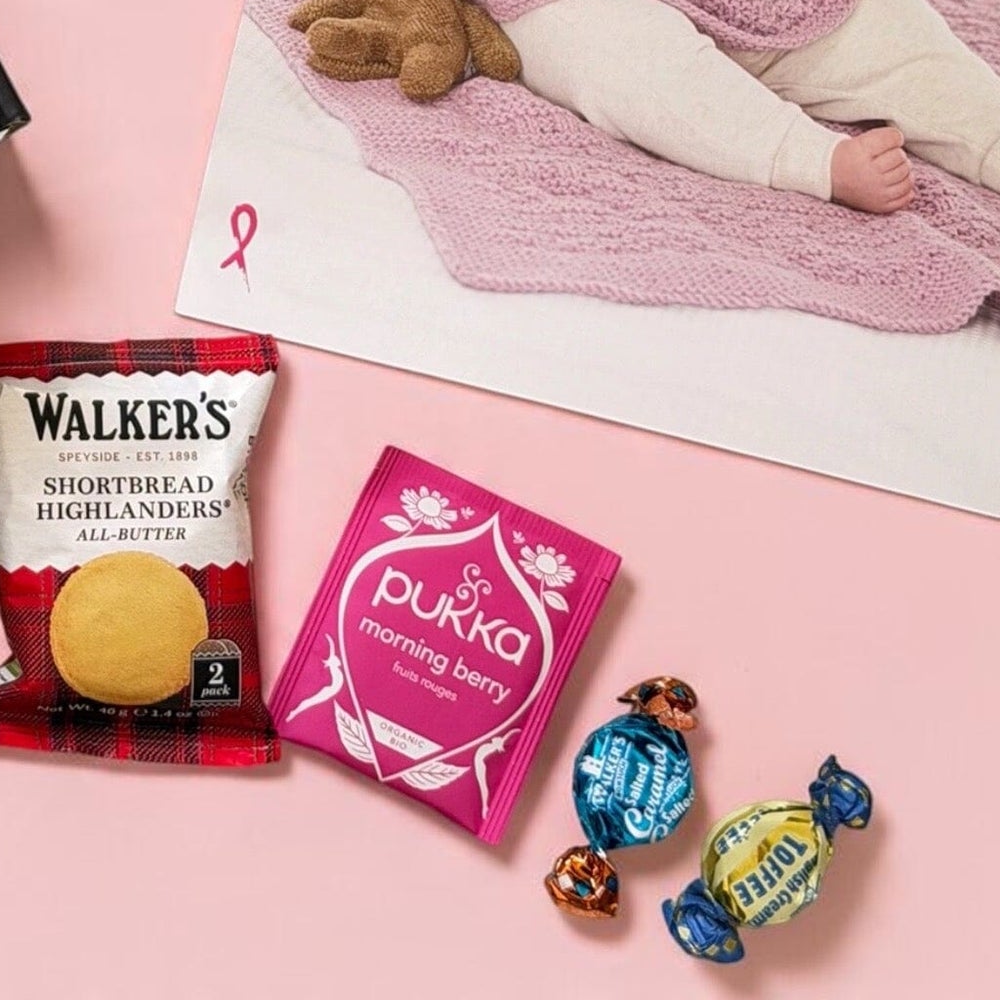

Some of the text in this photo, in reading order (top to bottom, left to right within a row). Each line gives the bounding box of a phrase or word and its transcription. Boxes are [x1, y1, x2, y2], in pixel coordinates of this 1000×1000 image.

[58, 451, 121, 462] SPEYSIDE
[136, 451, 164, 462] EST.
[168, 451, 198, 462] 1898
[43, 475, 214, 496] SHORTBREAD
[76, 527, 187, 542] ALL-BUTTER
[358, 616, 511, 705] morning berry
[208, 662, 225, 685] 2
[391, 662, 458, 703] fruits rouges
[200, 684, 232, 698] pack
[379, 721, 426, 749] ORGANIC
[389, 737, 408, 751] BIO
[624, 743, 668, 839] Caramel
[625, 762, 649, 808] Salted
[732, 834, 808, 908] TOFFEE
